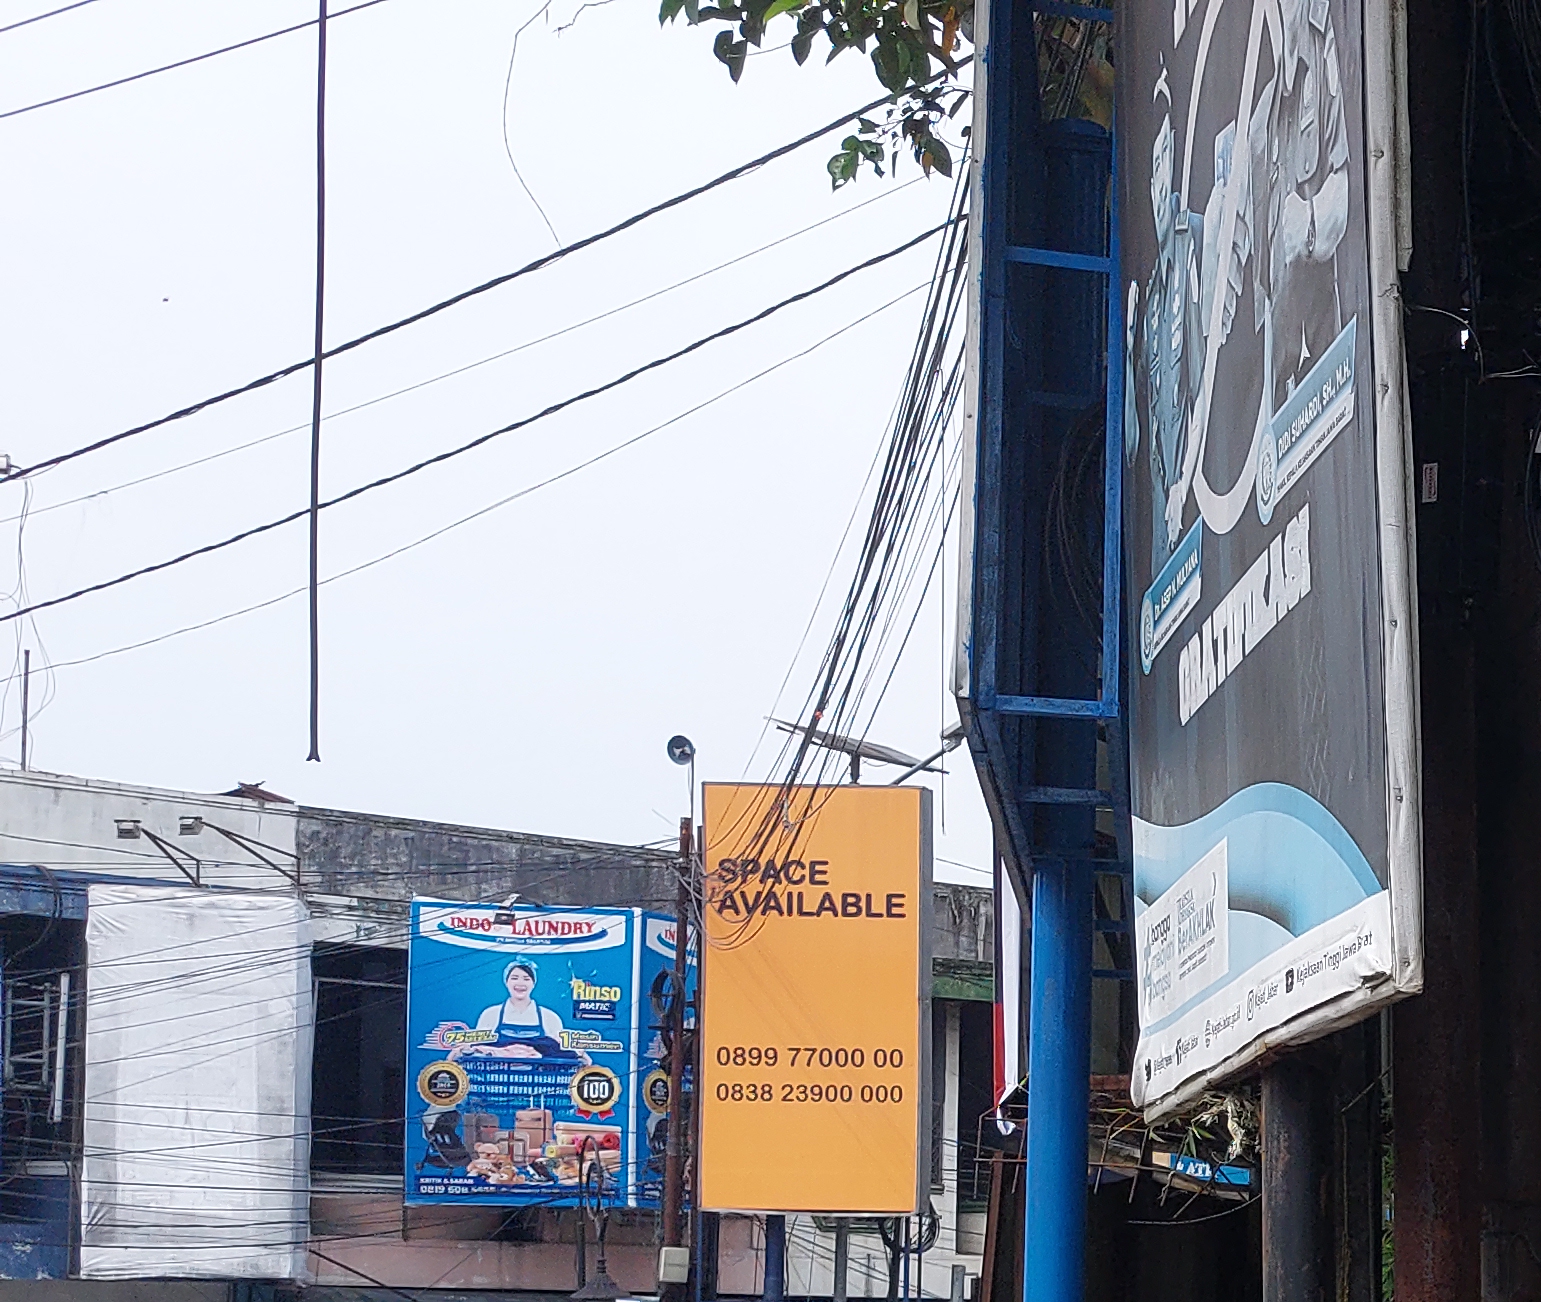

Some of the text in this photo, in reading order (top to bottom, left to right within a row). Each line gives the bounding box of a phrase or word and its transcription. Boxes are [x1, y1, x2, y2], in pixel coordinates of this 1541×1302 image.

[717, 859, 830, 887] SPACE
[717, 891, 907, 919] AVAILABLE
[450, 916, 598, 937] INDO LAUNDRY
[573, 979, 622, 1001] Rinso
[446, 1031, 465, 1044] 75
[559, 1031, 570, 1049] 1
[716, 1046, 904, 1070] 0899 77000 00
[582, 1080, 609, 1099] 100
[716, 1082, 904, 1104] 0838 23900 000
